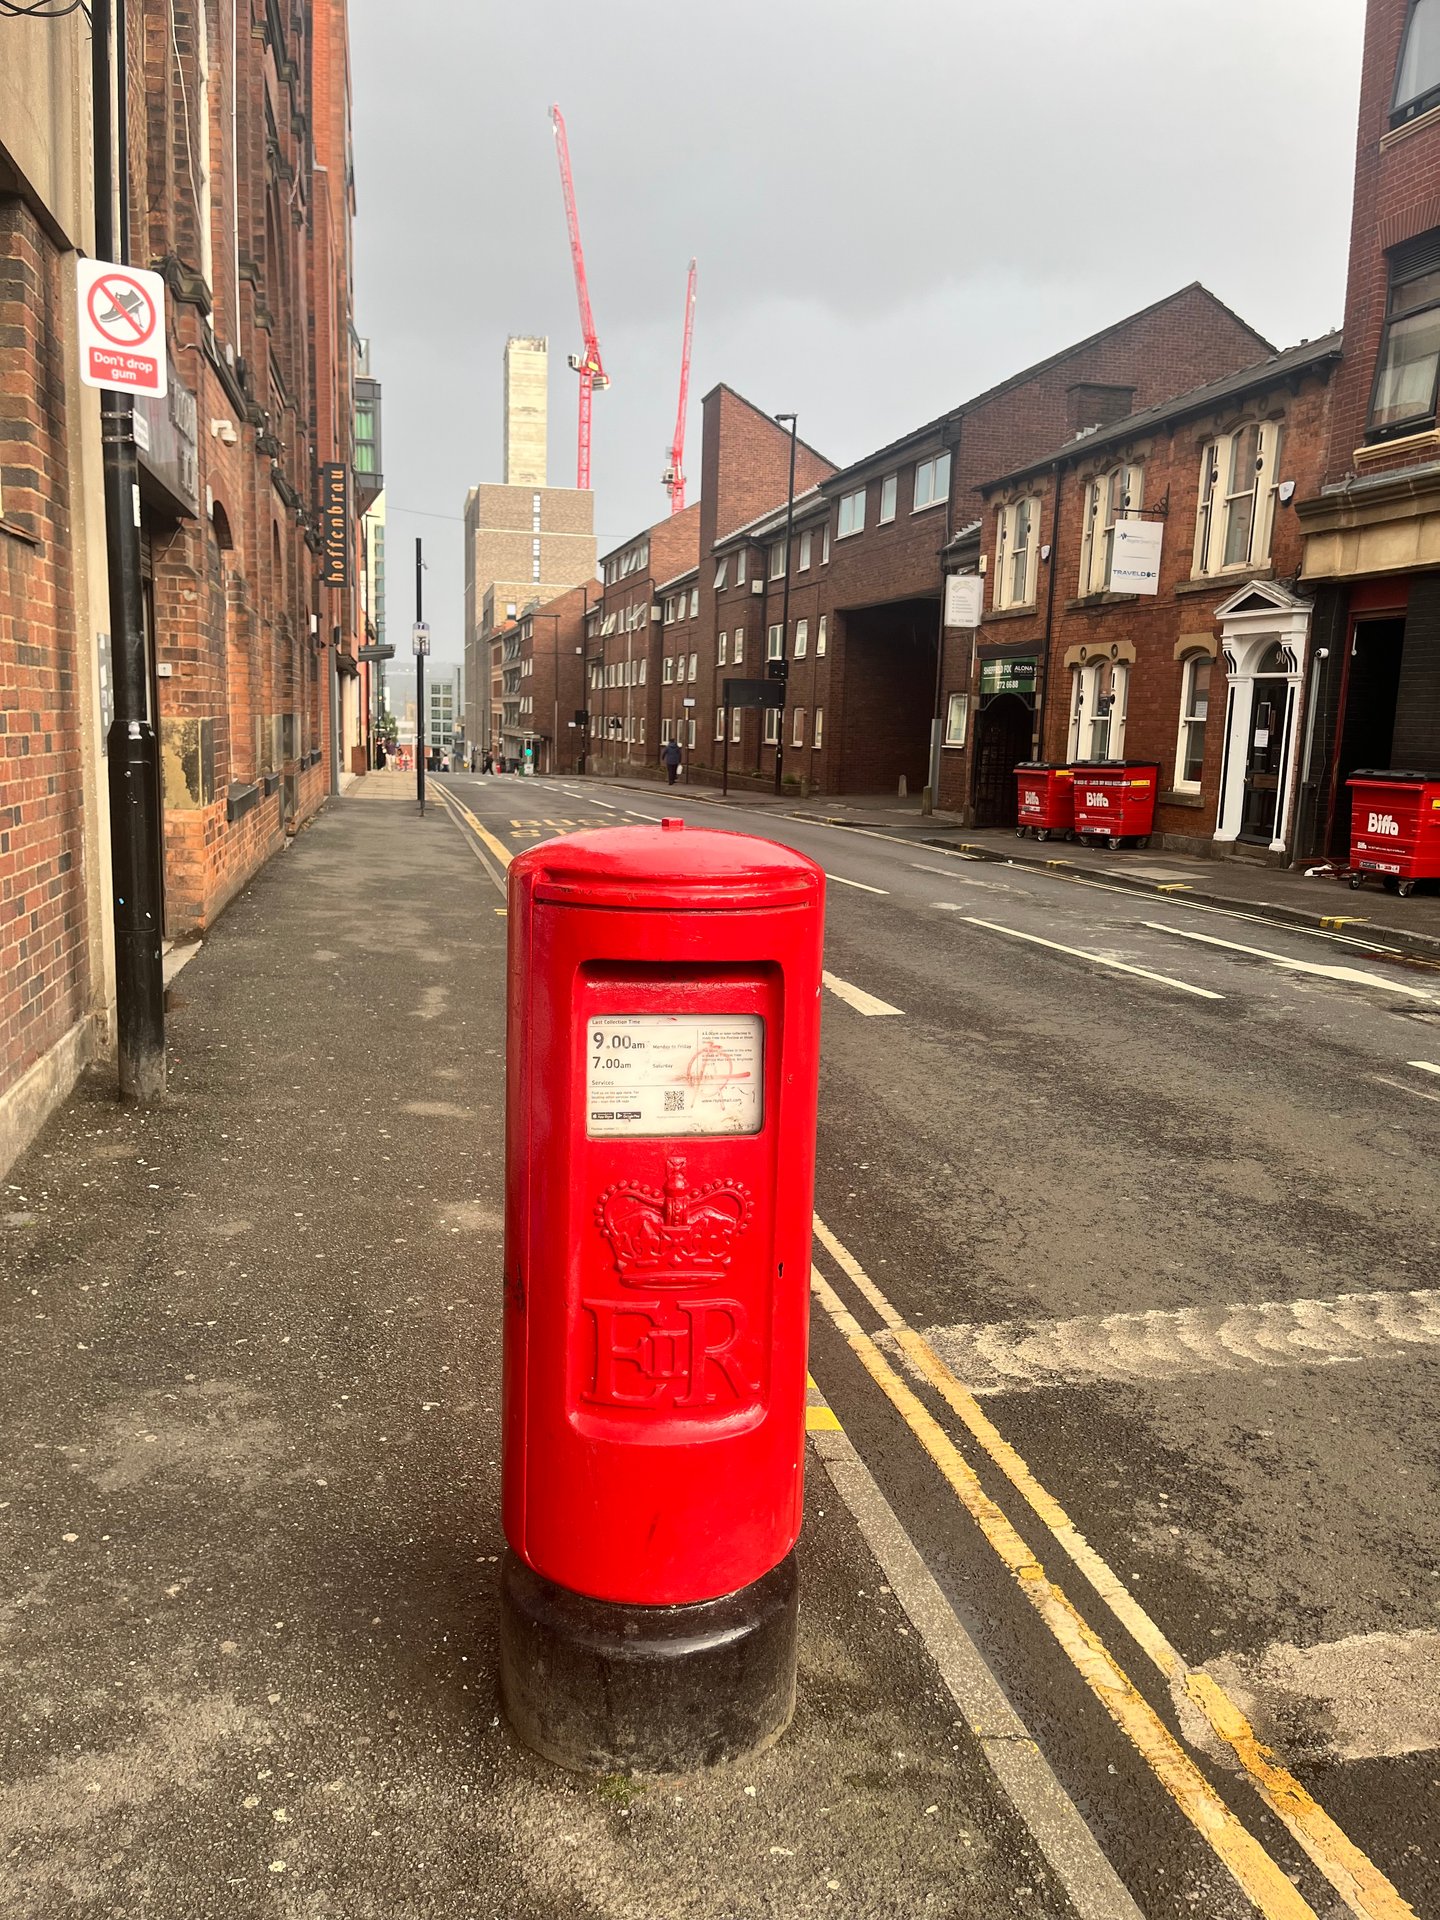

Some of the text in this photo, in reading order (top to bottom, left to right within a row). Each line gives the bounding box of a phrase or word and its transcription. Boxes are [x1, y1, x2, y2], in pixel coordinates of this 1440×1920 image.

[94, 352, 153, 374] Don't drop
[111, 369, 136, 380] gum
[326, 469, 346, 584] hoffenbrau
[1113, 569, 1157, 578] TRAVELDOC
[1024, 790, 1040, 805] Biffa
[1086, 792, 1110, 808] Biffa
[1368, 812, 1399, 836] Biffa
[593, 1032, 645, 1050] 9.00am
[592, 1056, 632, 1069] 7.00am
